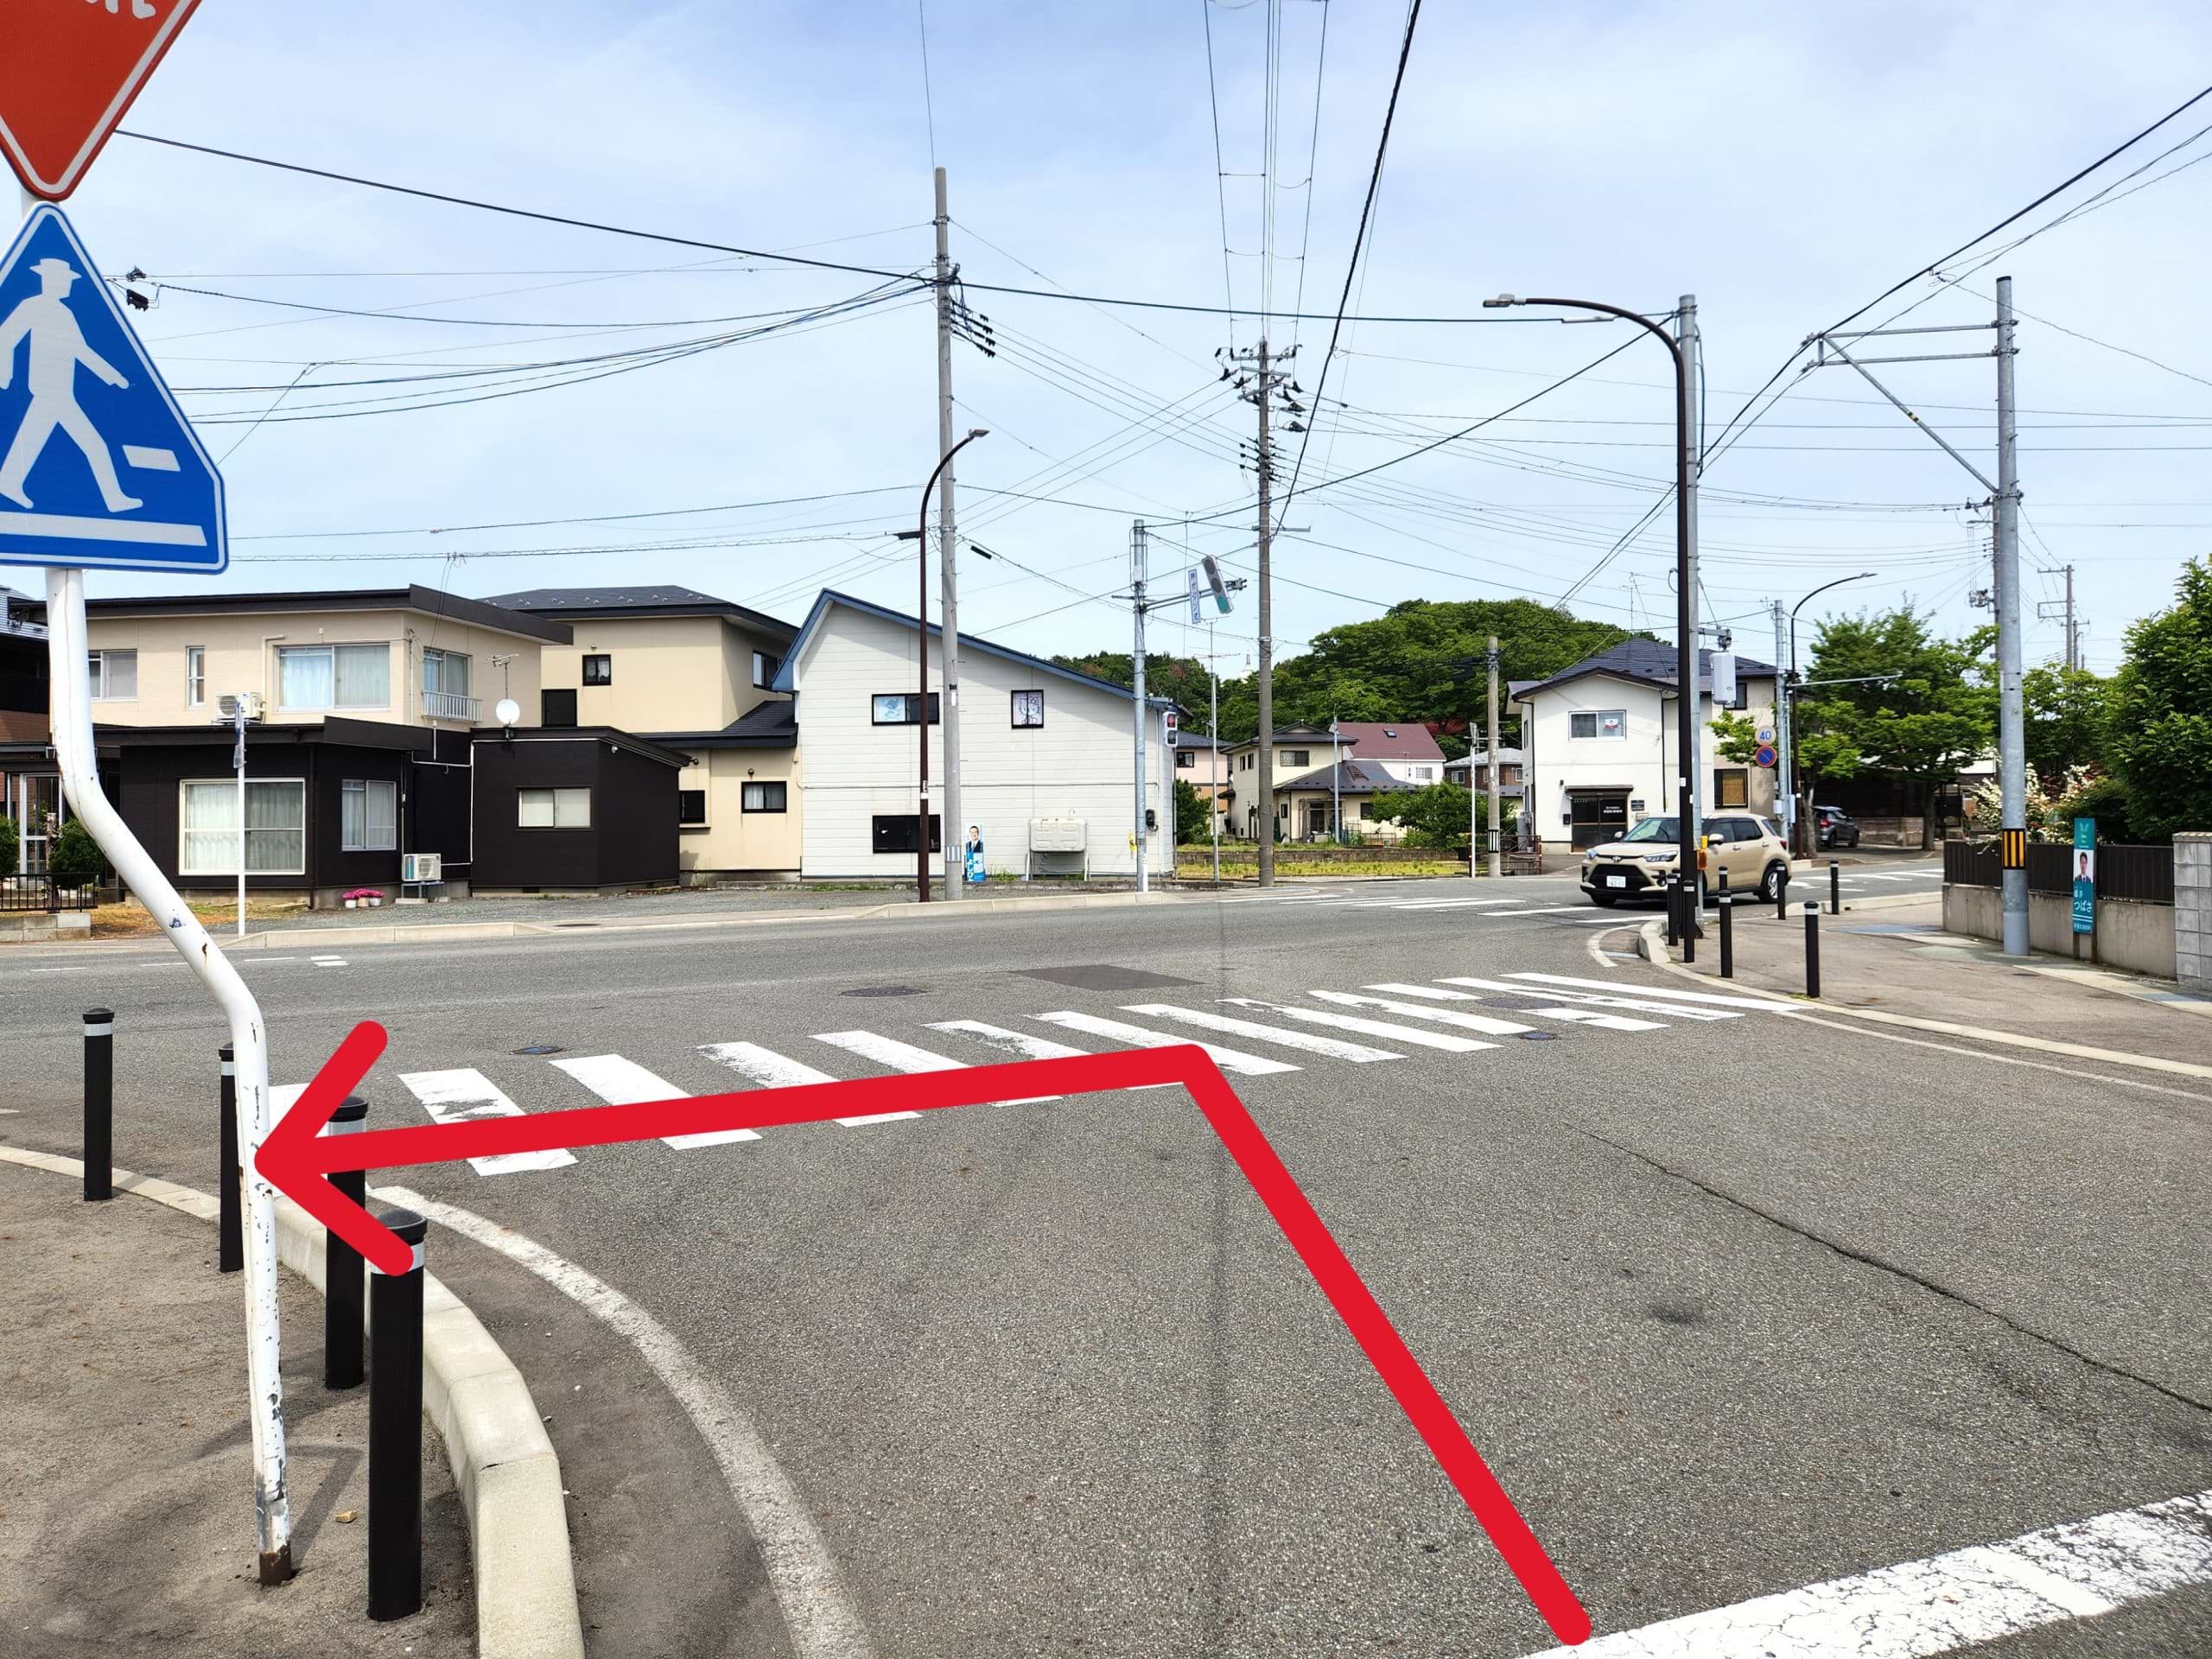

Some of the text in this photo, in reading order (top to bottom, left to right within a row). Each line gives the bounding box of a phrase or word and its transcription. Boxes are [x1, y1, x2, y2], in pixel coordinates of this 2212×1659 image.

[1759, 730, 1771, 741] 40
[2074, 900, 2092, 913] つばさ
